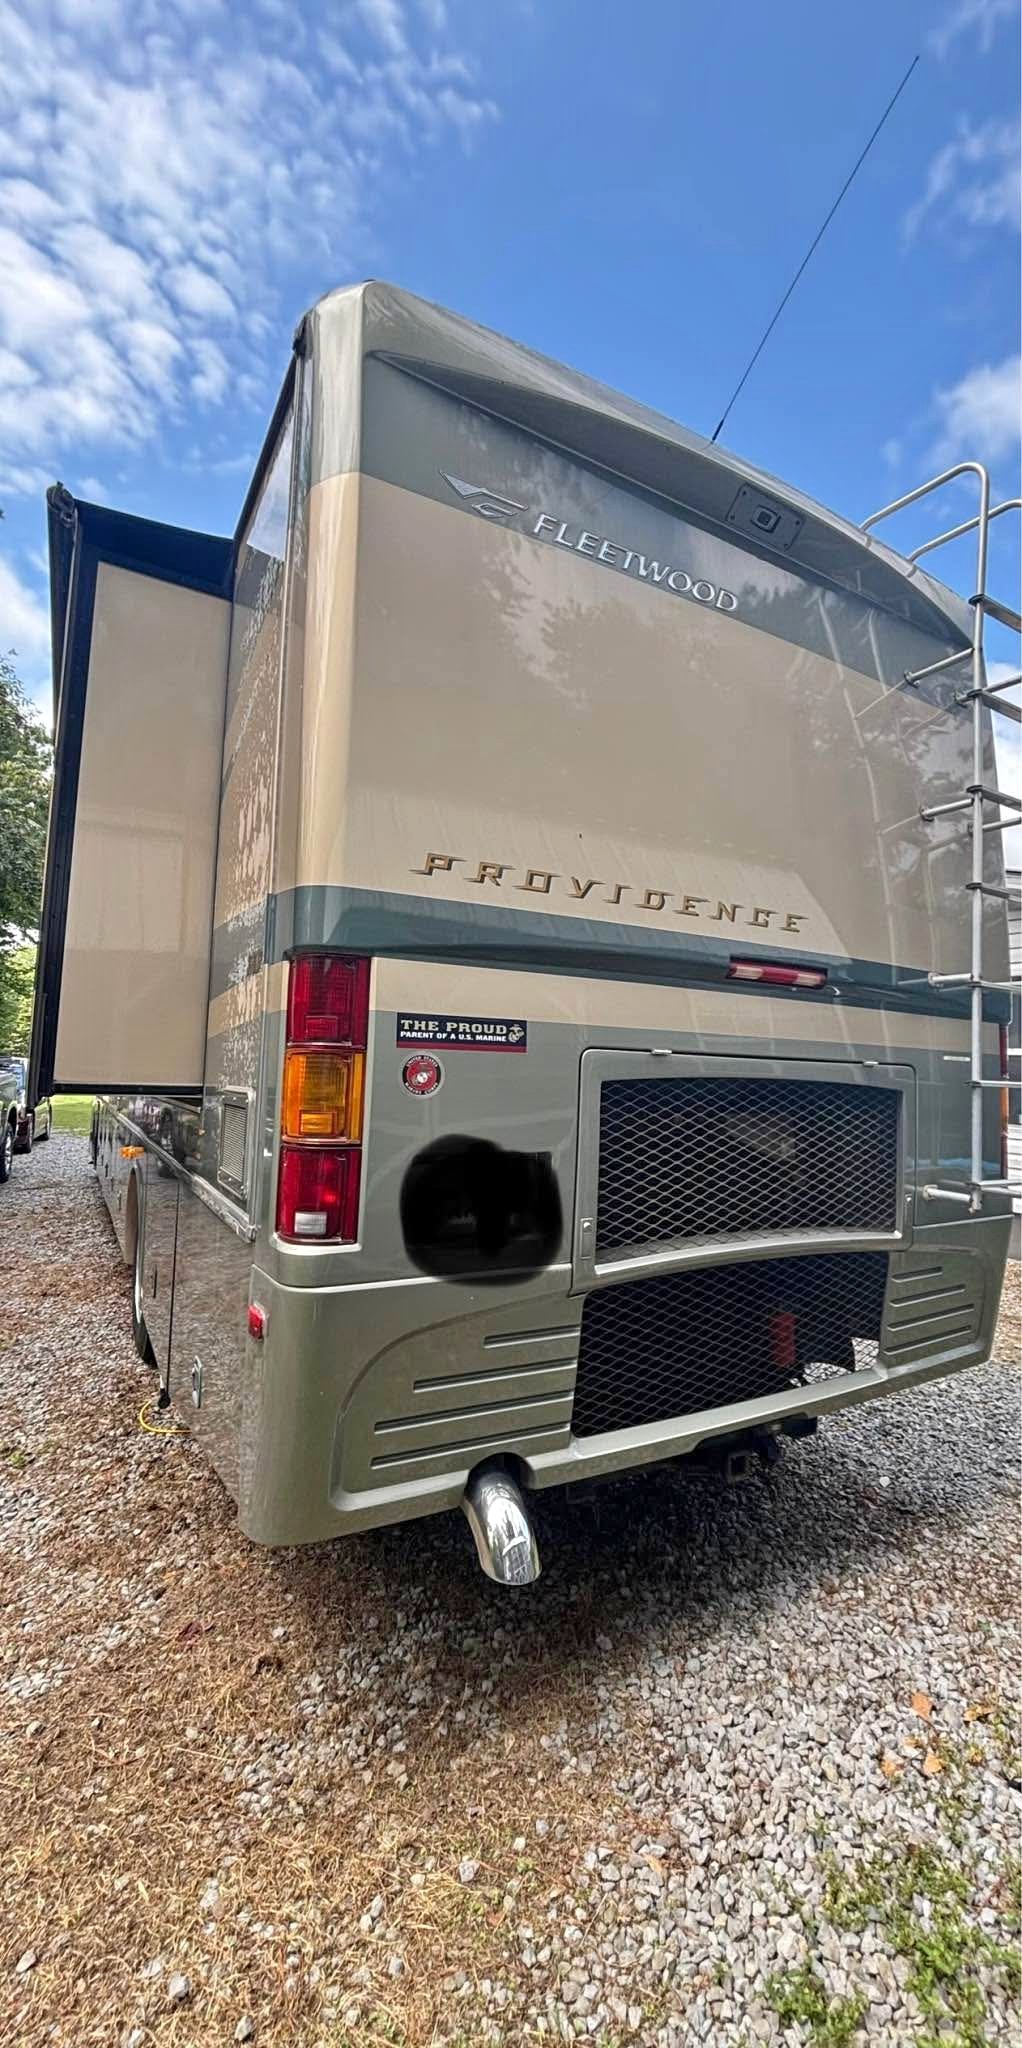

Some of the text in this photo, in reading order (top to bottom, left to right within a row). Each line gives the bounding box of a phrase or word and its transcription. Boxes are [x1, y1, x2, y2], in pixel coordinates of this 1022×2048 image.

[533, 512, 739, 613] FLEETWOOD
[409, 852, 808, 933] PROVIDENCE
[400, 1019, 507, 1034] THE PROUD
[400, 1031, 433, 1039] PARENT
[475, 1034, 507, 1042] MARINE
